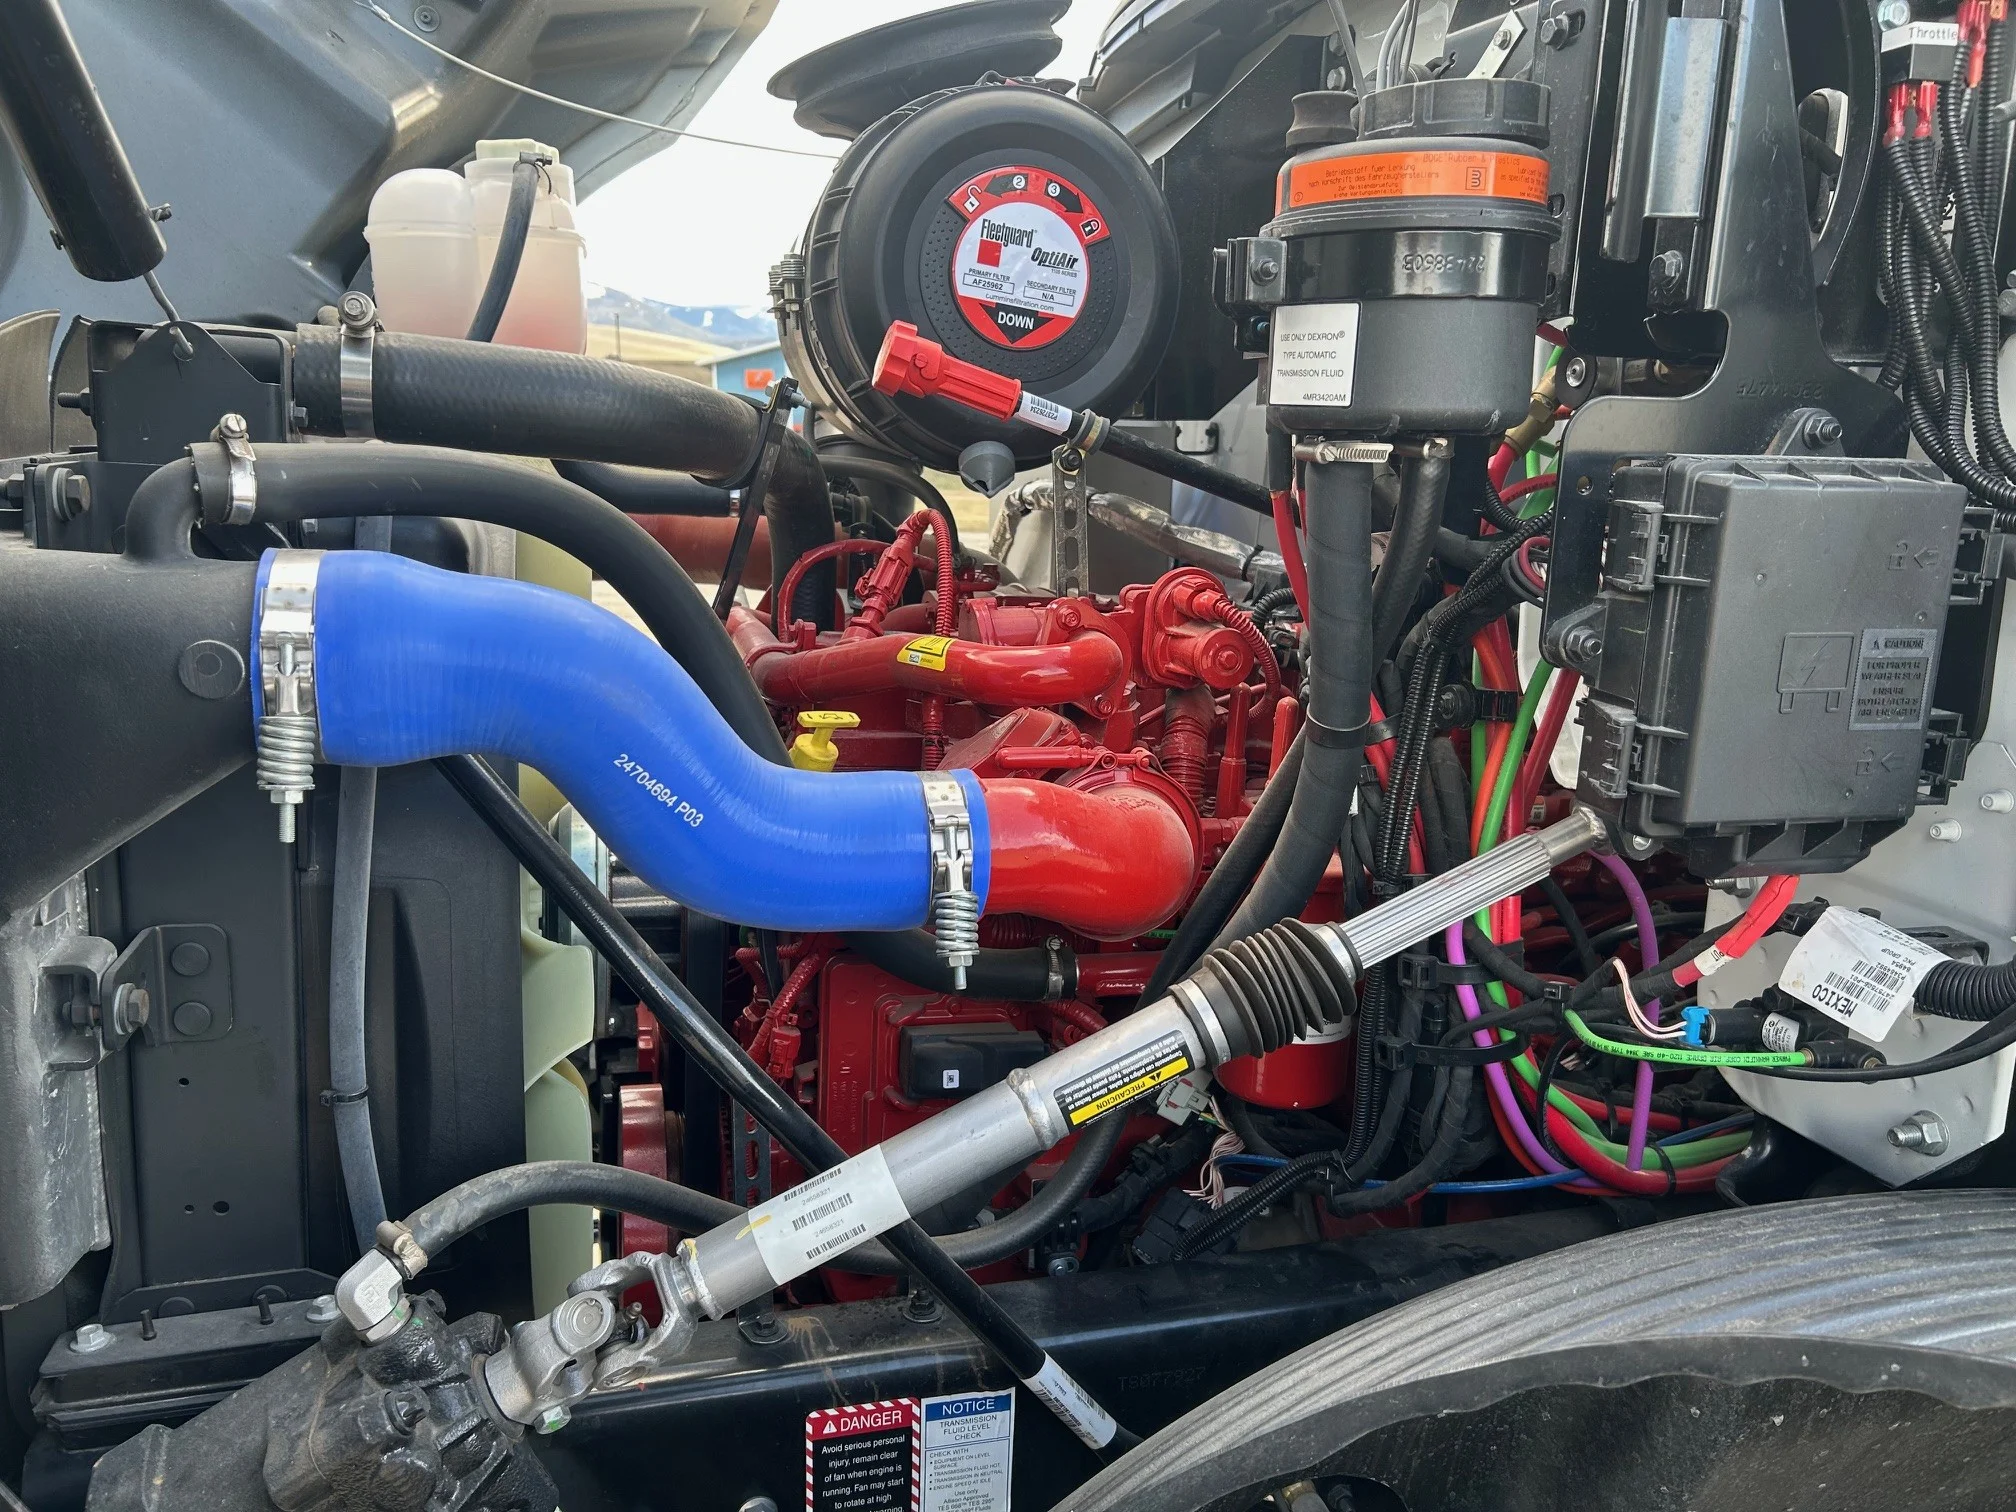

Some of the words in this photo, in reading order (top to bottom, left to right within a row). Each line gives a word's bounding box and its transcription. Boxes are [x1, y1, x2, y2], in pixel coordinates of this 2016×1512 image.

[1909, 27, 1958, 40] Throttle
[1016, 177, 1022, 187] 2
[1051, 185, 1058, 194] 3
[1031, 247, 1079, 269] OptiAir
[969, 268, 991, 278] PRIMARY
[992, 273, 1010, 281] FILTER
[972, 278, 1004, 290] AF25962
[1027, 280, 1057, 290] SECONDARY
[1059, 286, 1076, 295] FILTER
[986, 293, 1054, 312] cumminsfiltration.com
[1042, 292, 1054, 301] N/A
[998, 312, 1034, 329] DOWN
[1291, 333, 1306, 341] ONLY
[1297, 351, 1336, 359] AUTOMATIC
[1277, 369, 1319, 377] TRANSMISSION
[1884, 639, 1922, 648] CAUTION
[614, 754, 678, 807] 24704694
[674, 801, 704, 827] P03
[1880, 945, 1901, 960] GROUP
[1810, 981, 1858, 1018] MEXICO
[1094, 1080, 1147, 1110] PRECAUCION
[943, 1399, 995, 1415] NOTICE
[841, 1410, 902, 1431] DANGER
[940, 1414, 997, 1428] TRANSMISSION
[944, 1426, 965, 1435] FLUID
[968, 1423, 990, 1431] LEVEL
[955, 1432, 981, 1440] CHECK
[822, 1444, 842, 1454] Avoid
[845, 1441, 871, 1451] serious
[873, 1434, 905, 1448] personal
[829, 1458, 850, 1468] injury,
[853, 1454, 878, 1464] remain
[880, 1451, 898, 1460] clear
[930, 1450, 951, 1458] CHECK
[934, 1456, 964, 1464] EQUIPMENT
[824, 1473, 832, 1482] of
[834, 1472, 845, 1481] fan
[847, 1469, 867, 1479] when
[869, 1465, 894, 1476] engine
[934, 1468, 973, 1476] TRANSMISSION
[934, 1475, 972, 1483] TRANSMISSION
[955, 1480, 971, 1488] SPEED
[822, 1486, 852, 1497] running.
[854, 1484, 868, 1492] Fan
[870, 1481, 885, 1490] may
[888, 1478, 904, 1486] start
[844, 1498, 865, 1507] rotate
[876, 1493, 891, 1503] high
[963, 1493, 989, 1501] Approved
